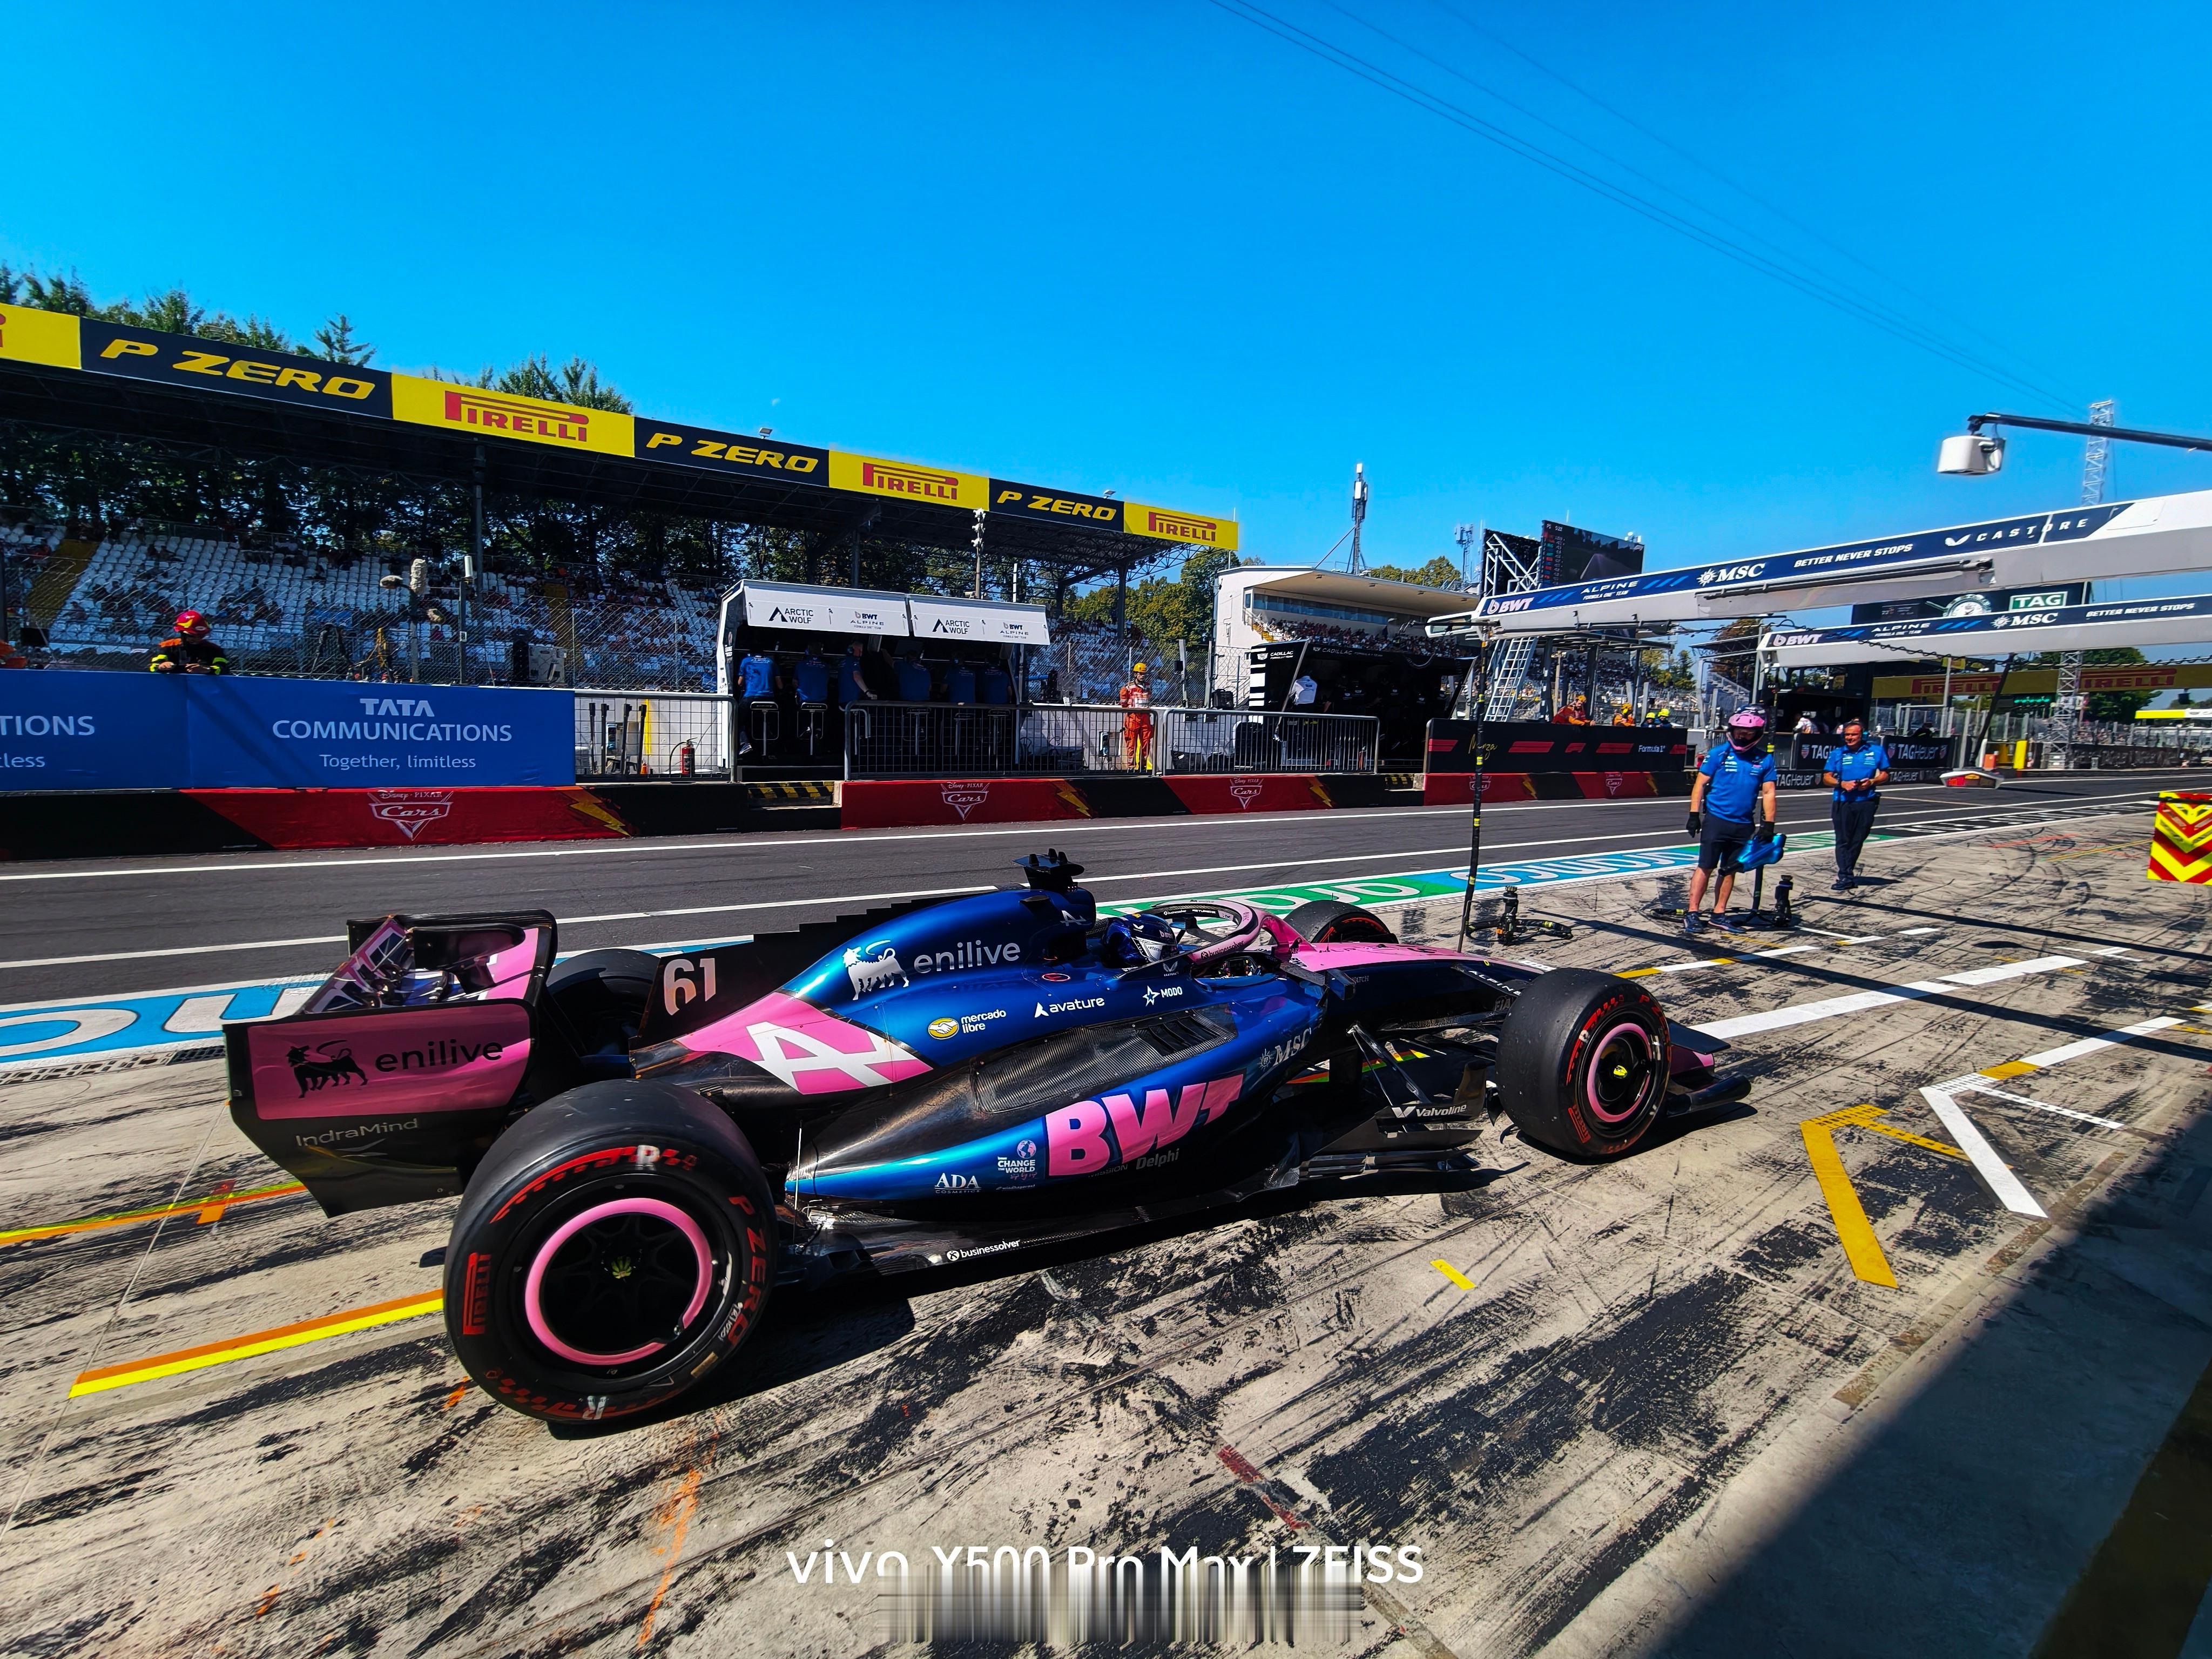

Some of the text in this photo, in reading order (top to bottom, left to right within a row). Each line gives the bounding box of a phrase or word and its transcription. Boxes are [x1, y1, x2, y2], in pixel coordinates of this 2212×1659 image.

[100, 339, 375, 400] P ZERO
[444, 390, 589, 442] PIRELLI
[646, 433, 819, 473] P ZERO
[862, 462, 959, 501] PIRELLI
[996, 490, 1117, 521] P ZERO
[1148, 511, 1217, 542] PIRELLI
[1794, 543, 1913, 568] BETTER NEVER STOPS
[1715, 562, 1766, 582] MSC
[1580, 580, 1639, 594] ALPINE
[1499, 597, 1534, 614] BWT
[2014, 594, 2062, 608] TAG
[2086, 602, 2195, 618] BETTER NEVER STOPS
[784, 608, 814, 617] ARCTIC
[788, 616, 812, 624] WOLF
[2009, 612, 2059, 626] MSC
[945, 619, 970, 628] ARCTIC
[949, 626, 969, 635] WOLF
[1871, 623, 1931, 632] ALPINE
[1786, 633, 1823, 646] BWT
[360, 698, 435, 717] TATA
[272, 719, 512, 742] COMMUNICATIONS
[319, 754, 476, 771] Together, limitless
[947, 794, 982, 802] Cars
[381, 806, 442, 817] Cars
[914, 940, 1021, 974] enilive
[1208, 940, 1244, 958] businessolver
[663, 957, 716, 1016] 61
[1468, 970, 1522, 996] ALPINE
[1161, 986, 1183, 999] MODO
[1049, 995, 1105, 1014] avature
[961, 1009, 1007, 1024] mercado
[962, 1022, 986, 1033] libre
[374, 1038, 504, 1073] enilive
[1274, 1028, 1312, 1067] MSC
[1415, 1104, 1467, 1117] Valvoline
[295, 1117, 419, 1147] IndraMind
[1045, 1074, 1244, 1176] BWT
[997, 1159, 1036, 1168] CHANGE
[1136, 1148, 1180, 1170] Delphi
[935, 1172, 980, 1190] ADA
[960, 1239, 1020, 1259] businessolver
